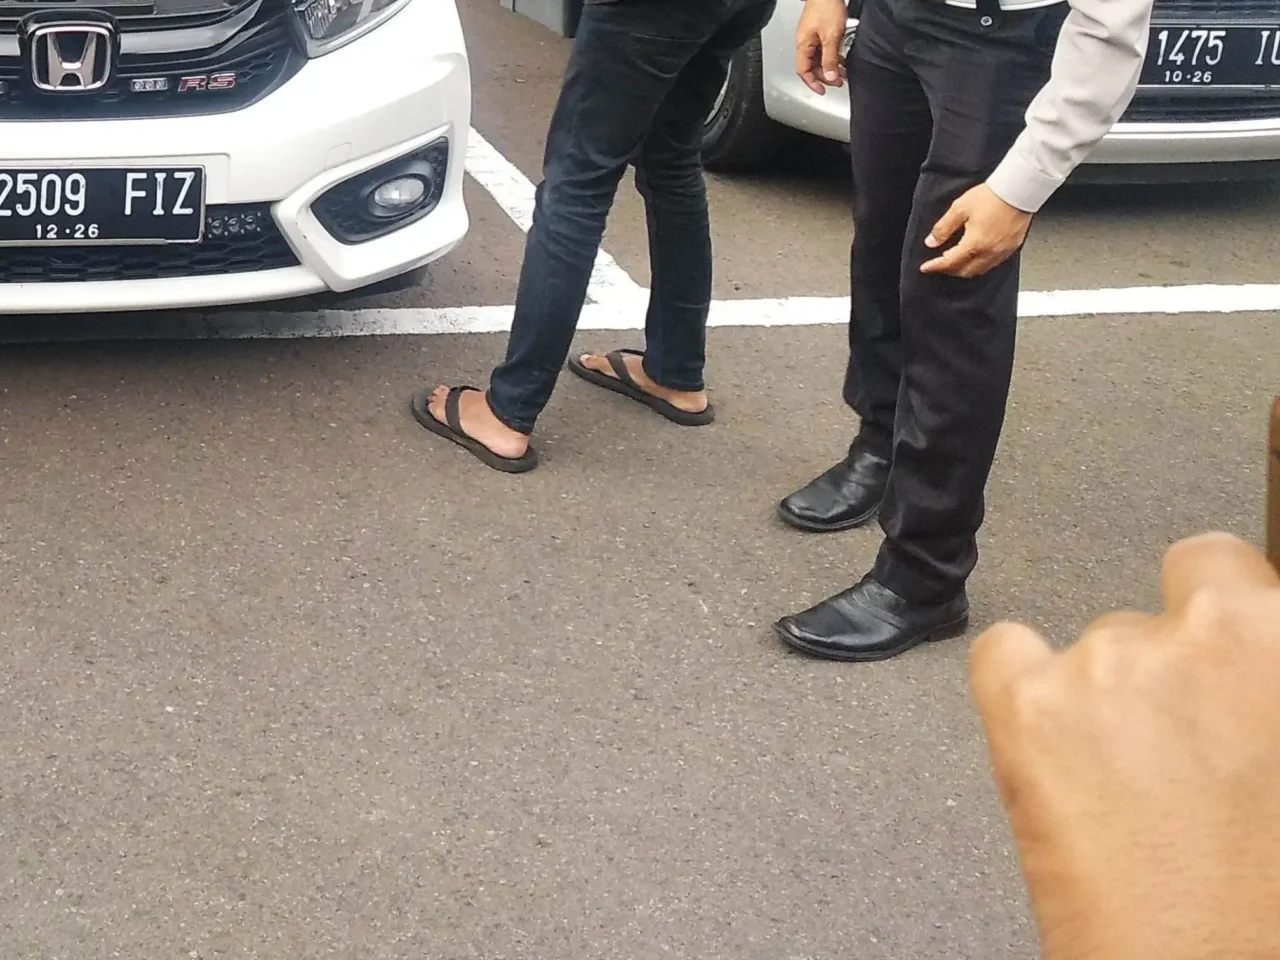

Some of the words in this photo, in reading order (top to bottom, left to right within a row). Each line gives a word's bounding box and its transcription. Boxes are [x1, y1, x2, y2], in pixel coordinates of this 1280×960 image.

[1157, 30, 1227, 66] 1475
[178, 73, 237, 92] RS
[124, 171, 196, 216] FIZ
